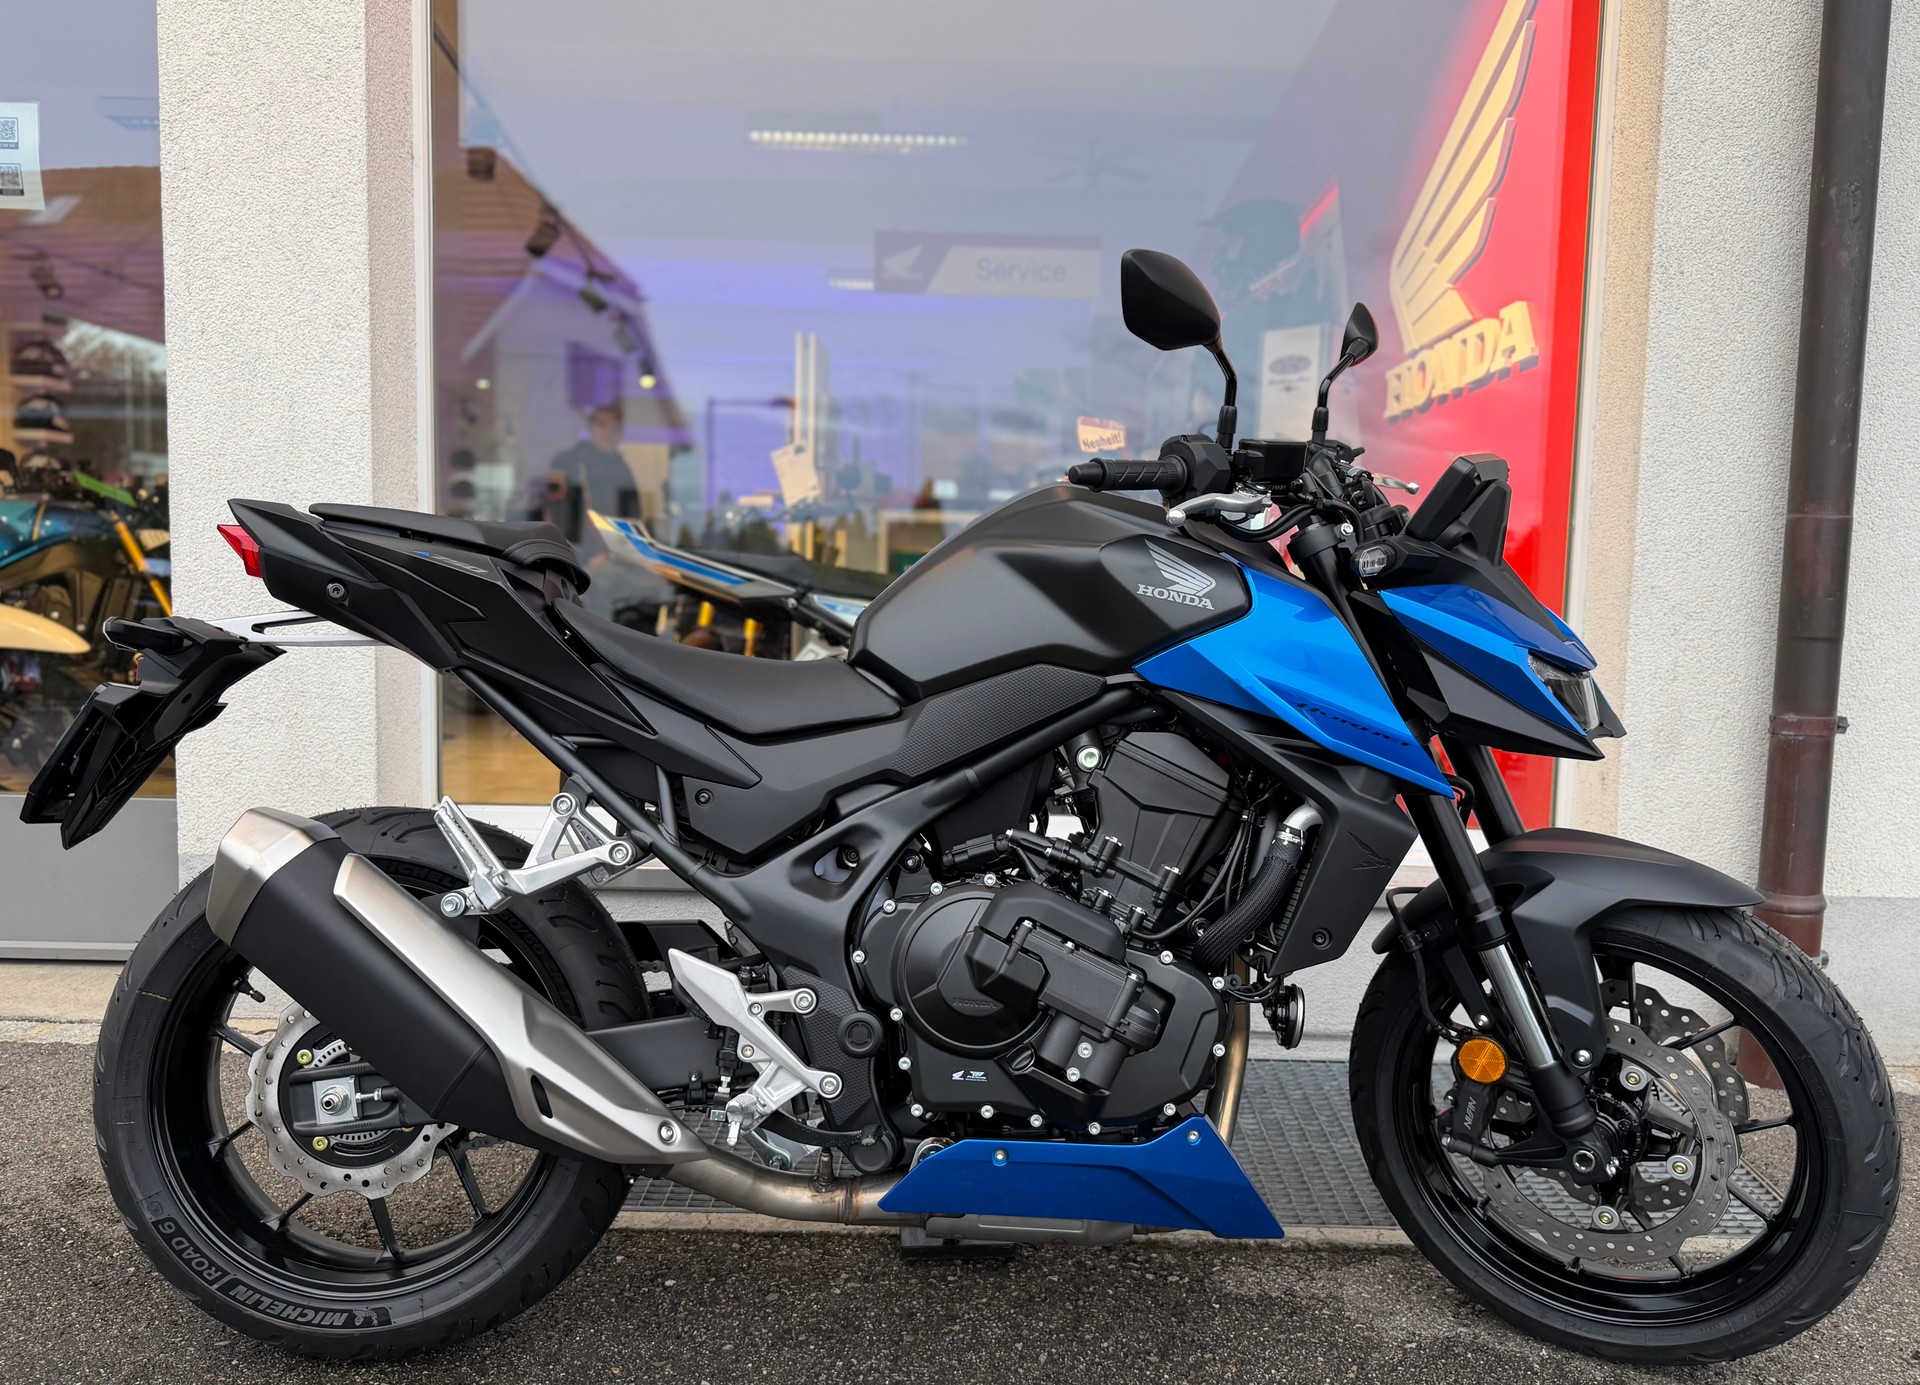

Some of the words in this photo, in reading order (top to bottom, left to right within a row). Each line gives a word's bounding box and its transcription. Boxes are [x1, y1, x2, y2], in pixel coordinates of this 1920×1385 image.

[976, 257, 1066, 282] Service
[1384, 301, 1540, 418] HONDA
[1082, 432, 1122, 450] Neuheit!
[1137, 584, 1214, 610] HONDA
[952, 998, 997, 1008] HONDA
[159, 1221, 176, 1235] 6
[171, 1236, 222, 1281] ROAD
[229, 1286, 349, 1326] MICHELIN
